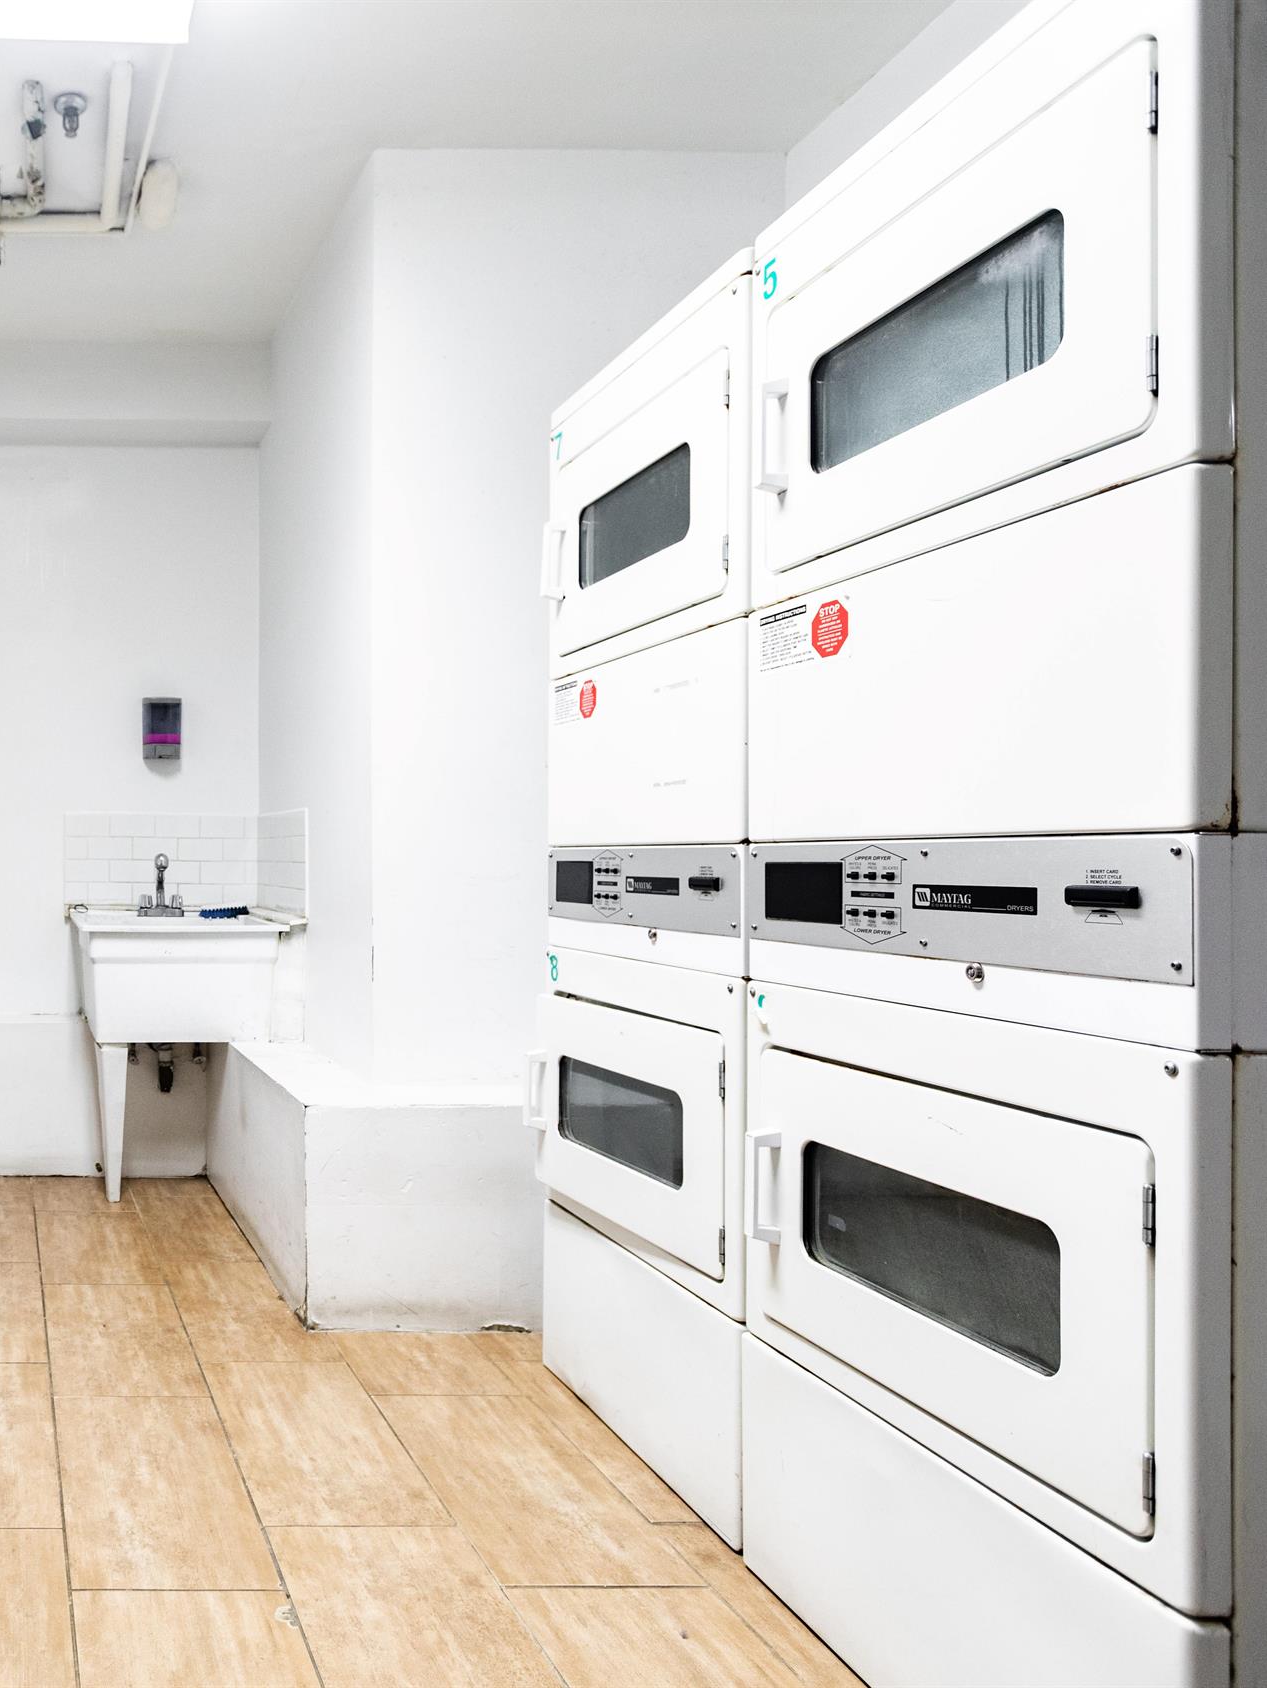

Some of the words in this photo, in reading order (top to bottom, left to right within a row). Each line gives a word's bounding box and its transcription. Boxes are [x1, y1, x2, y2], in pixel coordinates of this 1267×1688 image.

[763, 257, 777, 300] 5
[554, 432, 563, 461] 7
[820, 604, 840, 618] STOP
[931, 892, 972, 905] MAYTAG
[1006, 904, 1034, 912] DRYERS
[550, 955, 559, 982] 8
